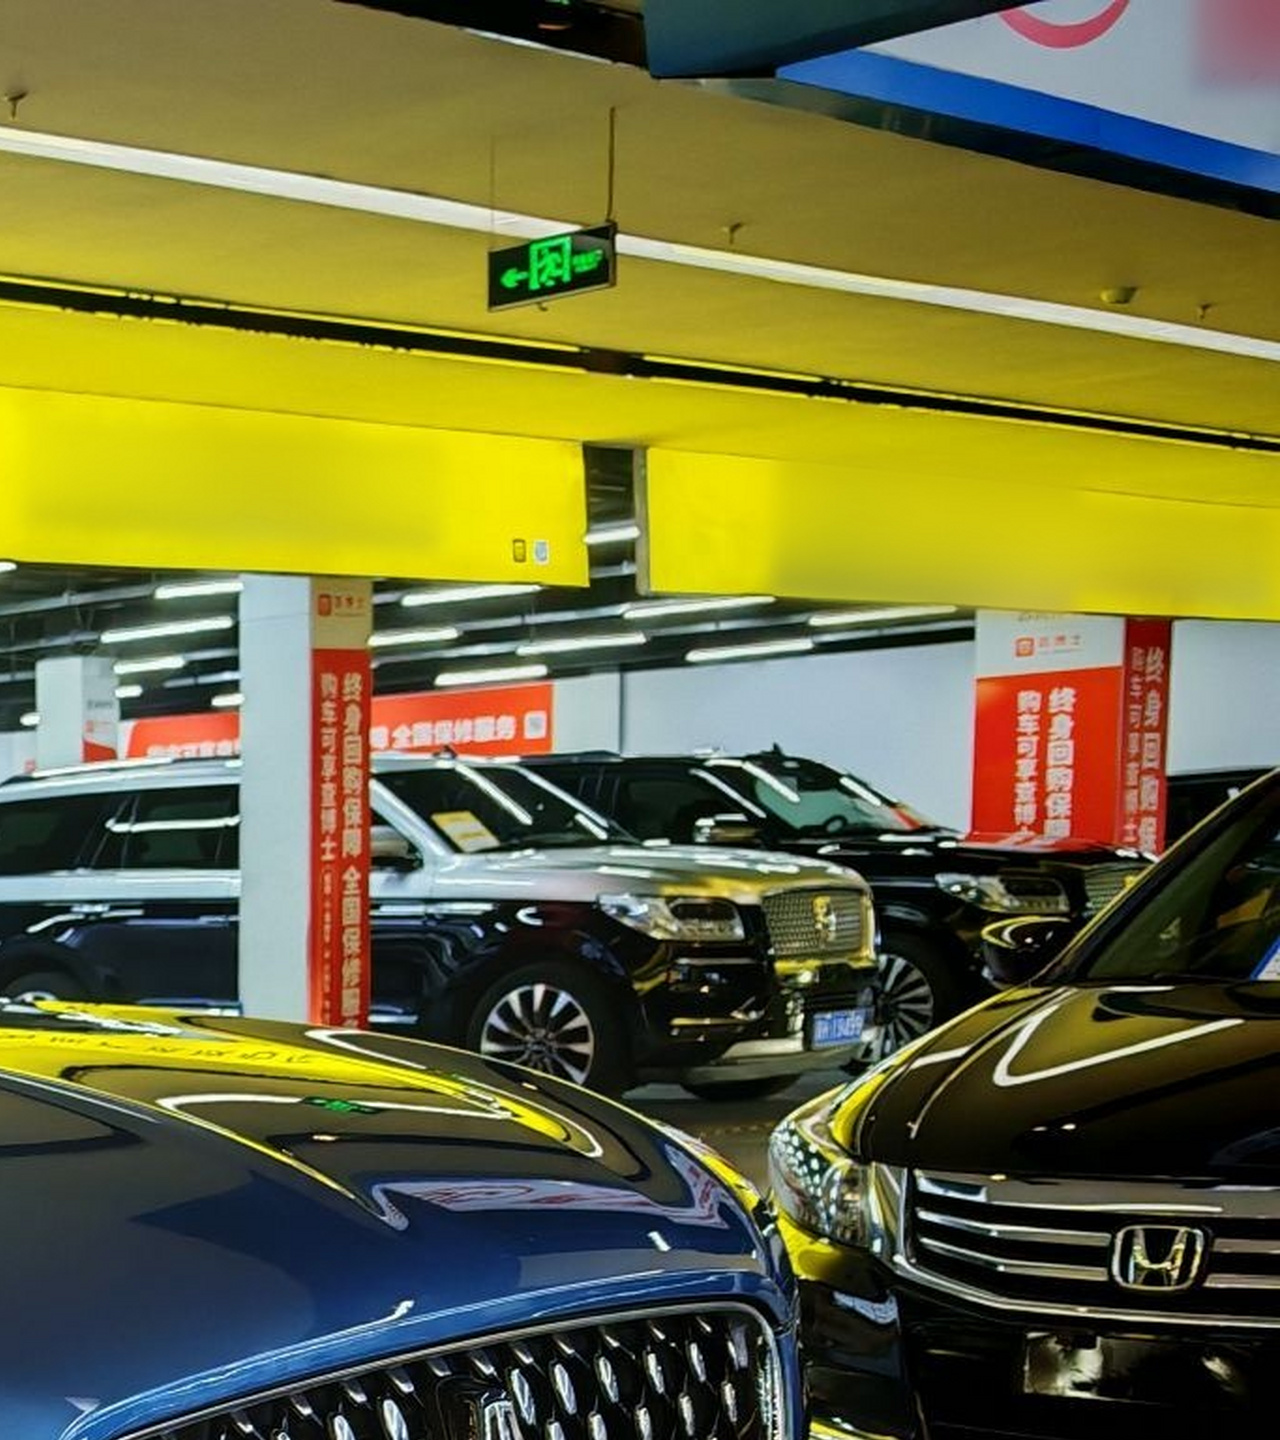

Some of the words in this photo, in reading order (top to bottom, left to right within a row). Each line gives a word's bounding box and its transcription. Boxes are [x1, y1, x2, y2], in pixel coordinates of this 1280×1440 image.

[342, 673, 362, 858] 终身回购保障
